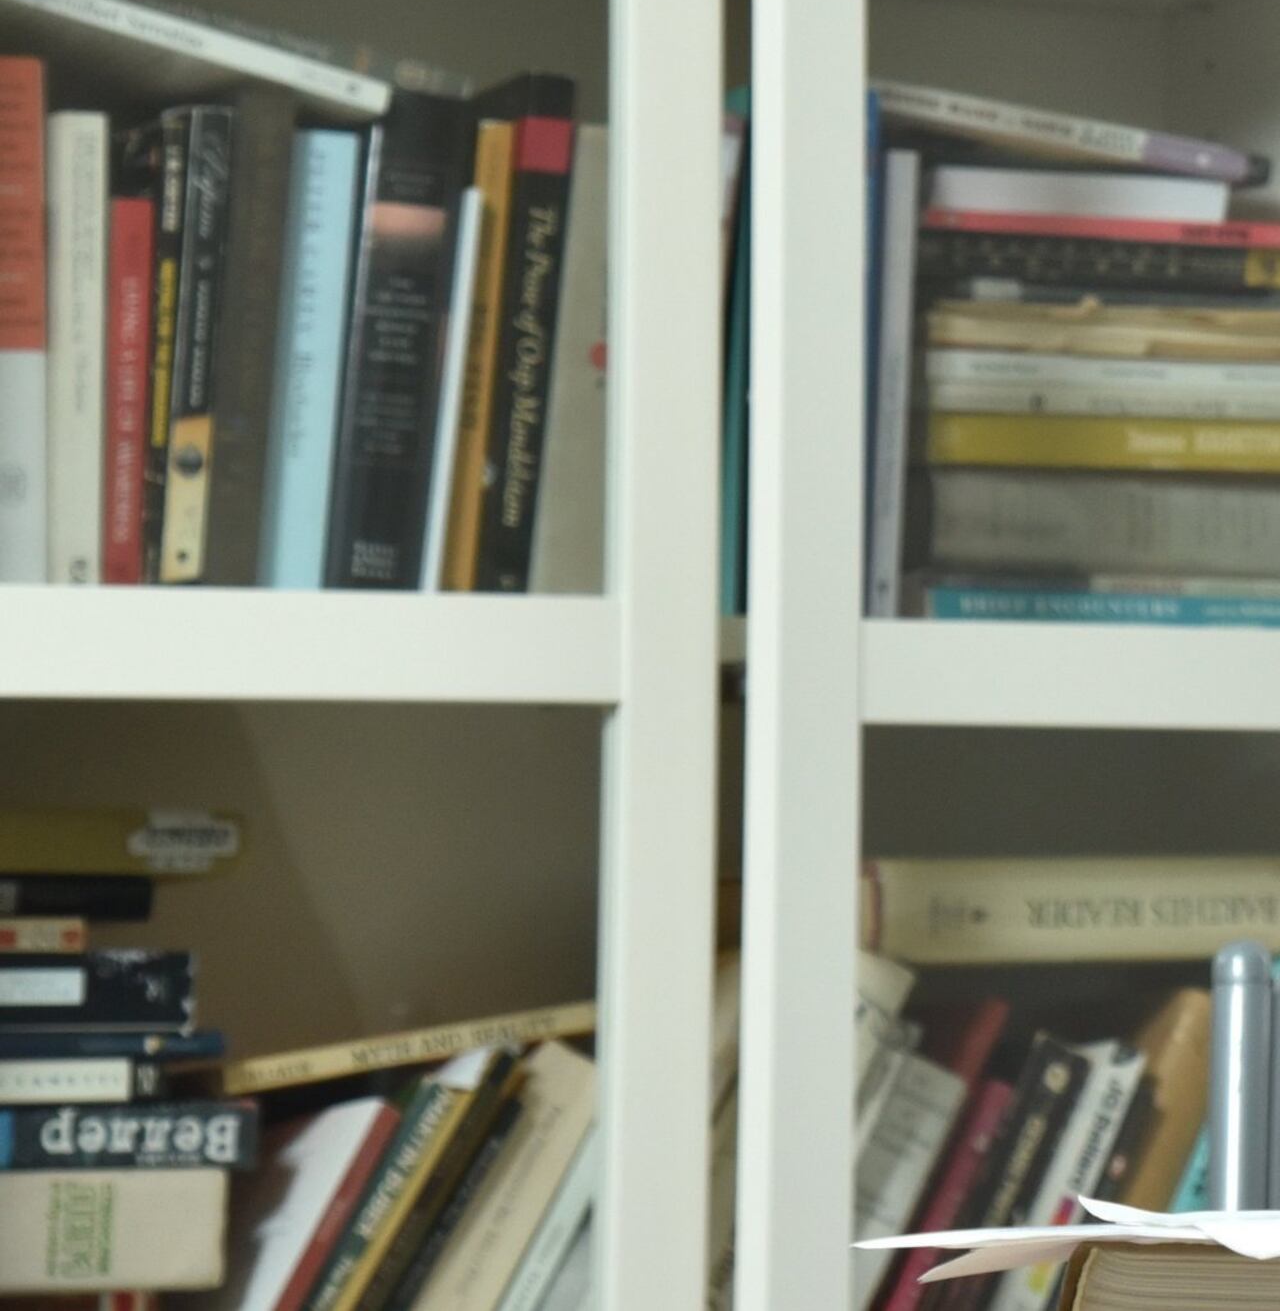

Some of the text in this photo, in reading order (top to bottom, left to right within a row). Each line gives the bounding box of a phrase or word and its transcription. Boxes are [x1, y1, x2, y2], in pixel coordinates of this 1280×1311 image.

[528, 206, 556, 245] The
[1026, 895, 1143, 928] READER
[351, 1042, 413, 1067] MYTH
[421, 1032, 463, 1055] AND
[40, 1110, 240, 1164] Веллер
